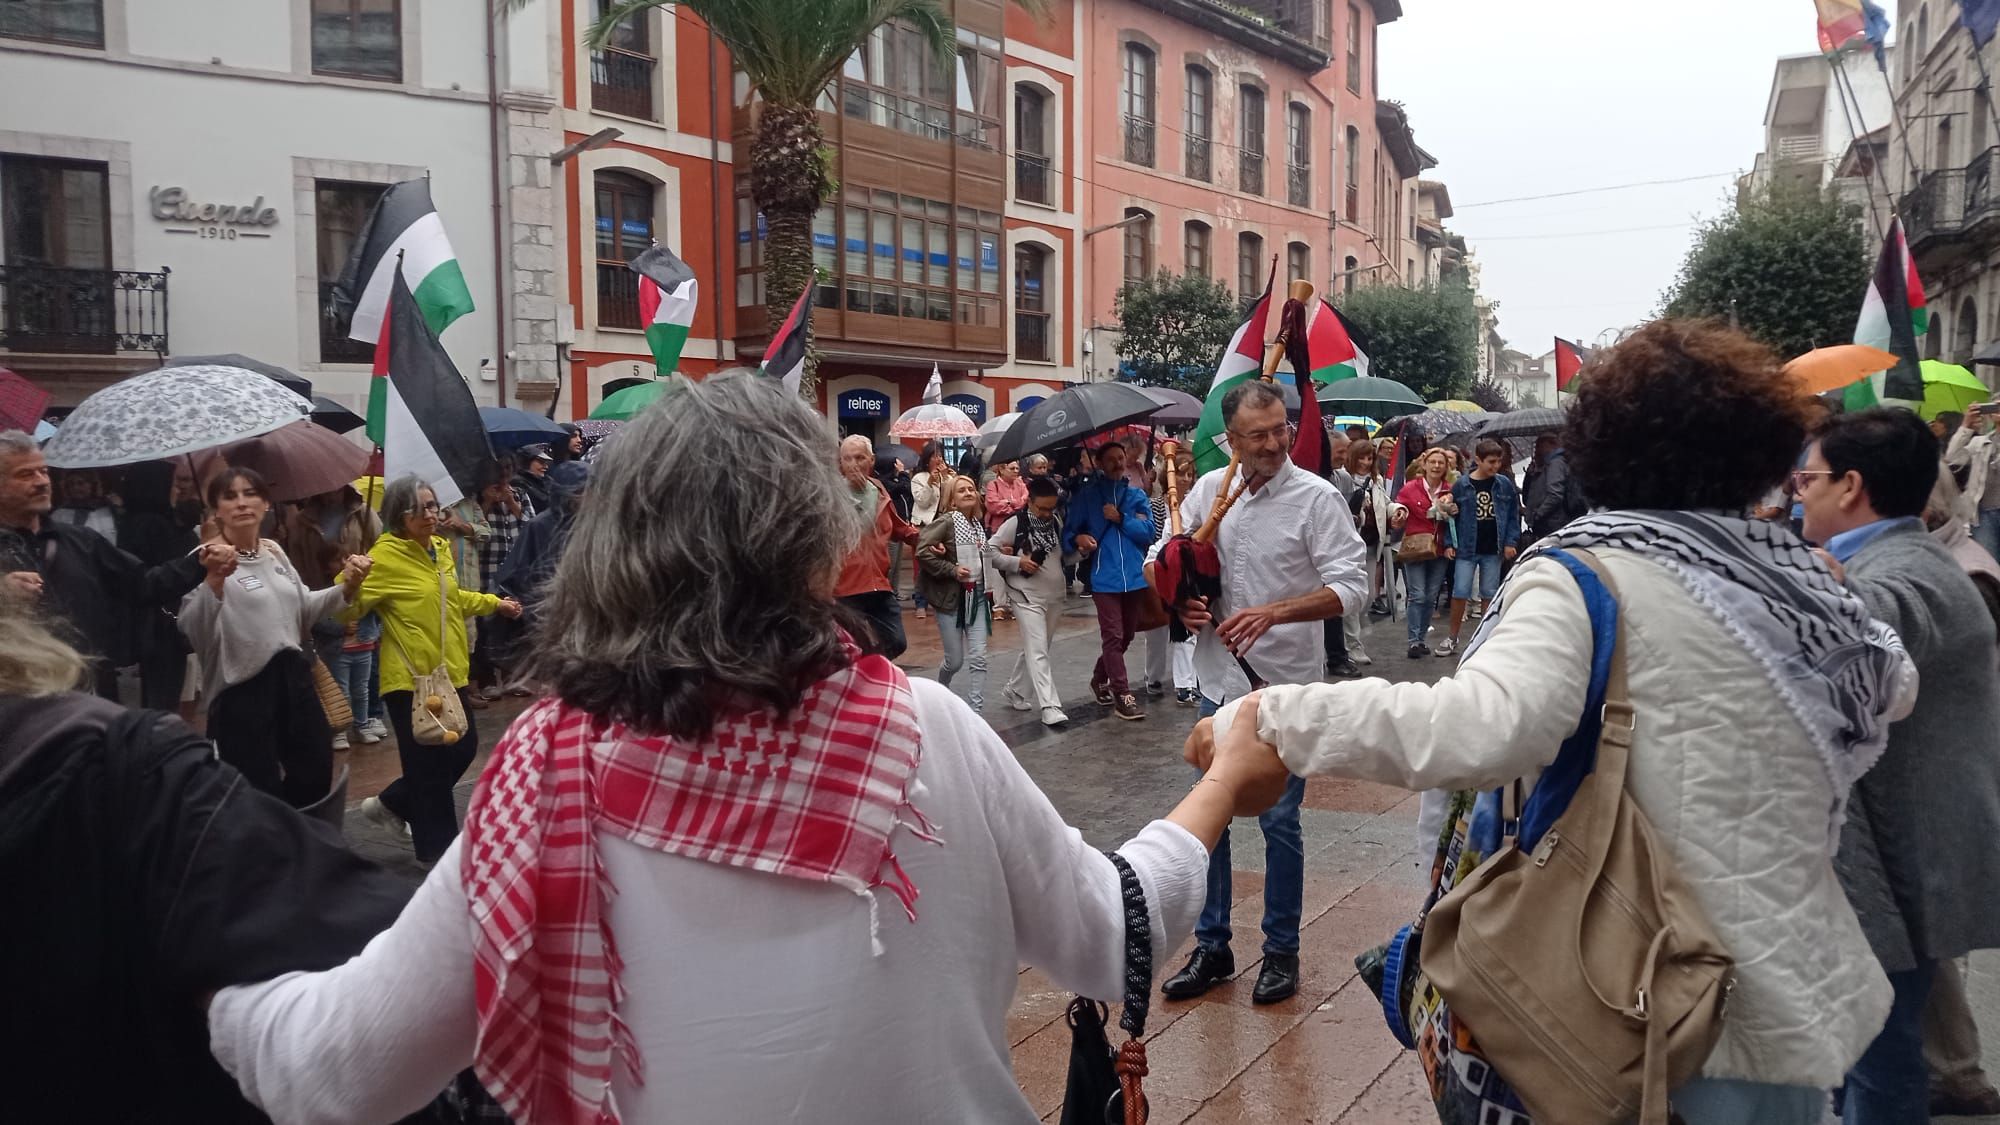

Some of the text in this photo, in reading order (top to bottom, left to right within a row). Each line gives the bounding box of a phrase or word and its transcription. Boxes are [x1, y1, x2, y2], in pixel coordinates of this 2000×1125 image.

[199, 227, 237, 241] 1910
[633, 364, 640, 376] 5
[848, 396, 881, 410] reines
